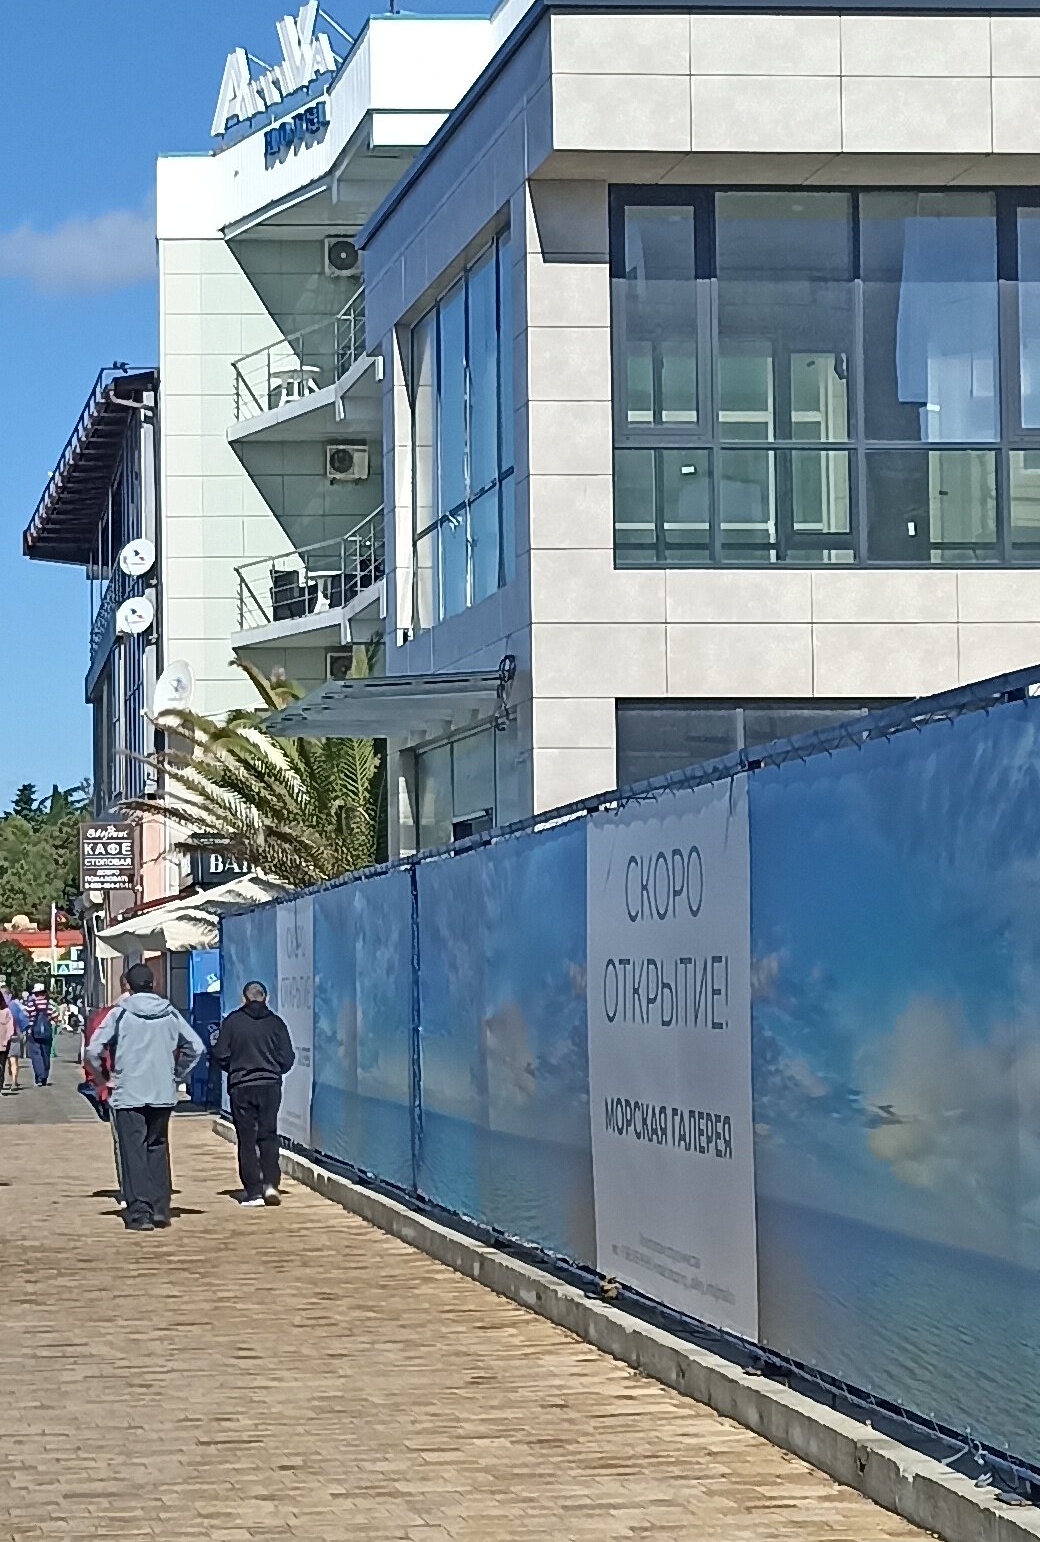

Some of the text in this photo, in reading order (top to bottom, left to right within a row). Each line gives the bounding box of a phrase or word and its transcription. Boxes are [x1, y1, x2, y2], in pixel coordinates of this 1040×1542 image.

[84, 843, 132, 855] КАФЕ
[84, 858, 132, 866] СТОЛОВАЯ
[625, 845, 704, 922] СКОРО
[604, 956, 730, 1030] ОТКРЫТИЕ!
[605, 1097, 733, 1160] МОРСКАЯ ГАЛЕРЕЯ
